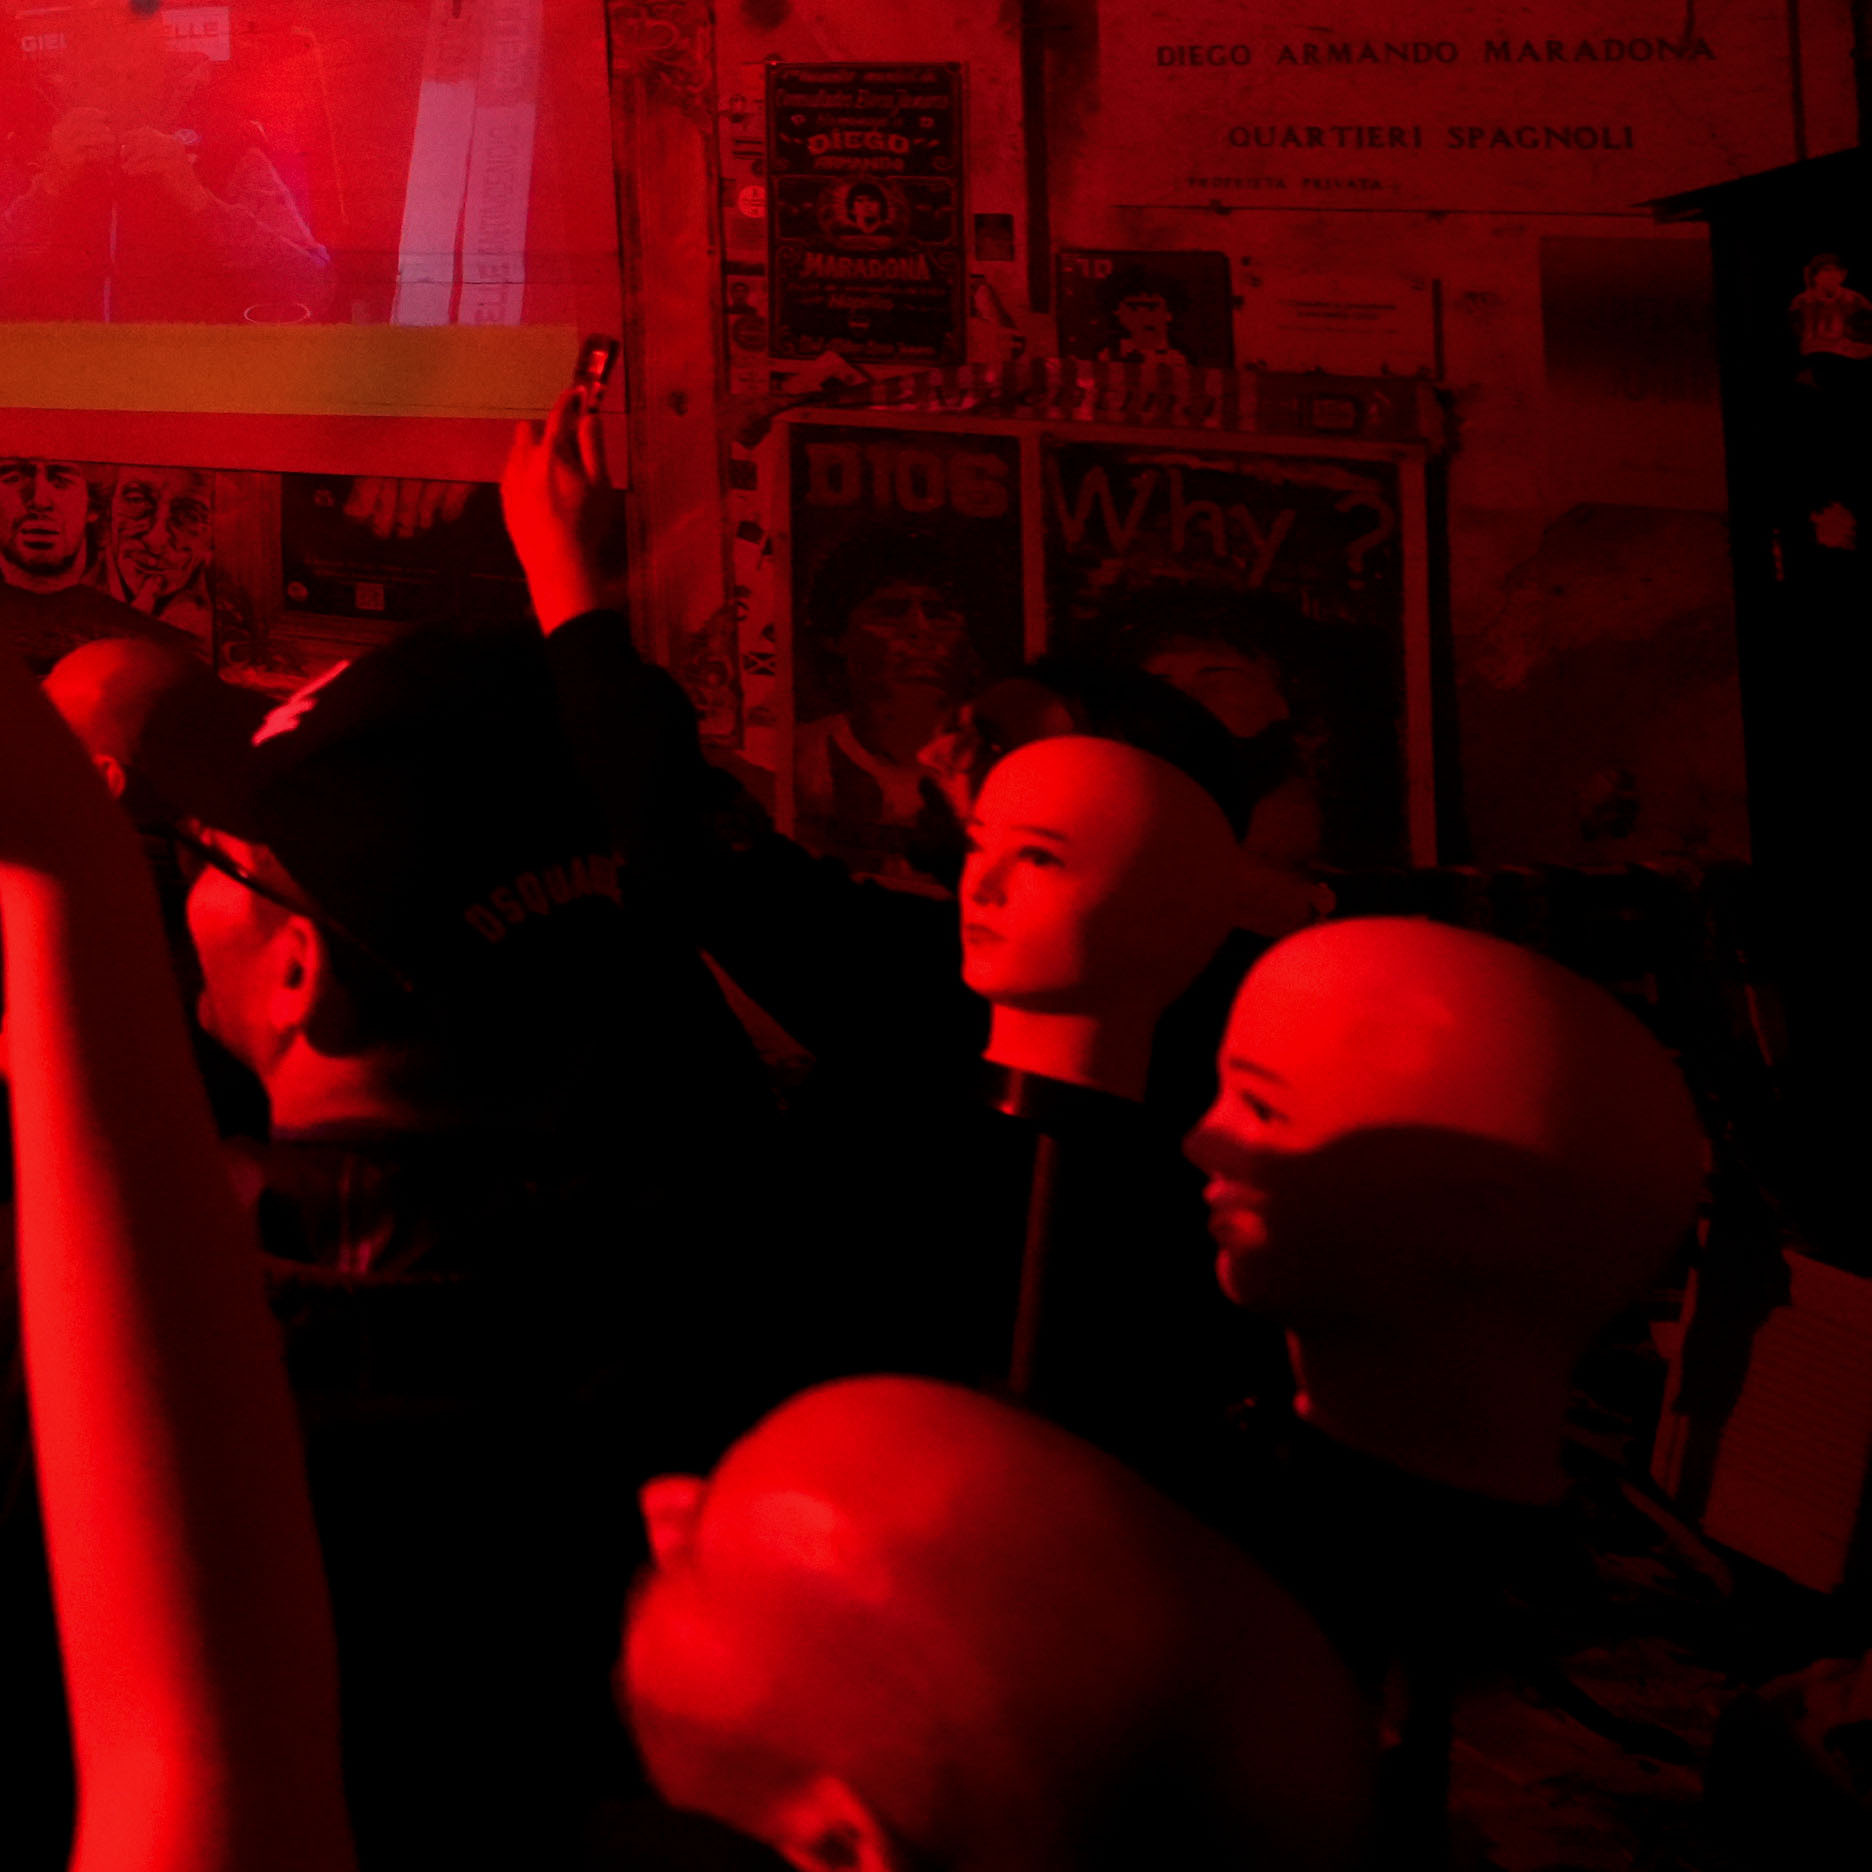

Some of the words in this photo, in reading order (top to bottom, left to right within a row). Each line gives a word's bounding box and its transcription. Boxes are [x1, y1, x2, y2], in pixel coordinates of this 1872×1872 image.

[1155, 43, 1253, 68] DIEGO
[1275, 39, 1460, 67] ARMANDO
[1482, 34, 1718, 65] MARADONA
[807, 129, 912, 156] DIEGO
[1227, 123, 1423, 151] QUARTIERI
[1446, 123, 1636, 151] SPAGNOLI
[1044, 448, 1297, 592] Why
